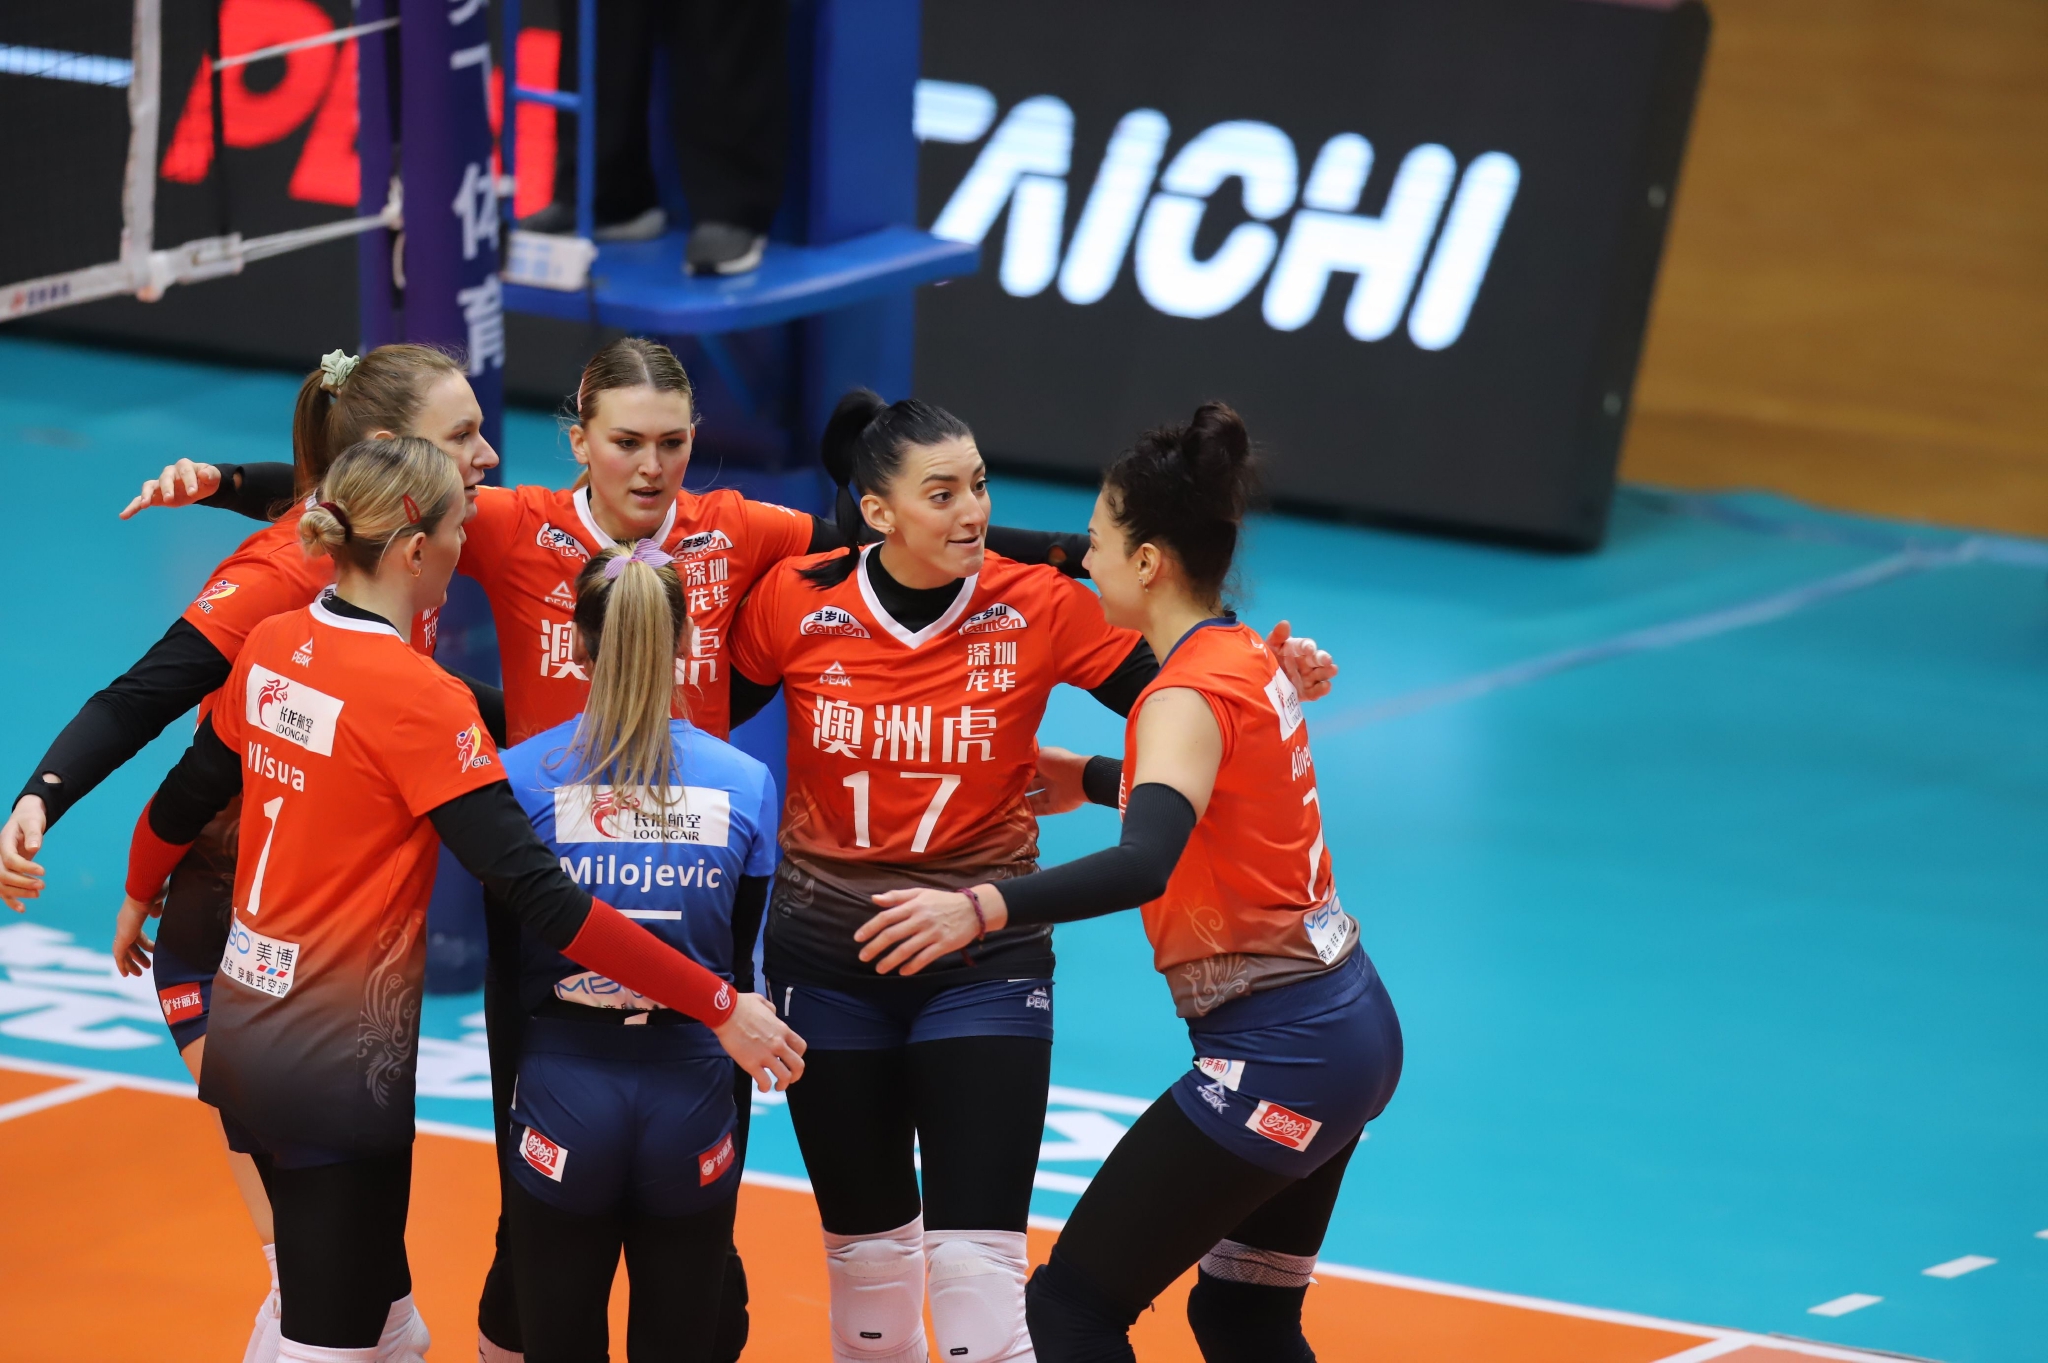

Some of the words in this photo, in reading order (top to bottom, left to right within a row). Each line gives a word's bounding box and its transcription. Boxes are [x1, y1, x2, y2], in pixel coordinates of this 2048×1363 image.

[684, 557, 729, 588] 深圳
[687, 584, 730, 614] 龙华
[291, 650, 314, 669] PEAK
[540, 618, 721, 686] 澳虎
[966, 641, 1018, 667] 深圳
[819, 673, 853, 688] PEAK
[965, 667, 1017, 693] 龙华
[279, 705, 314, 735] 长龙航空
[811, 693, 998, 764] 澳洲虎
[472, 755, 491, 768] CVL
[842, 770, 962, 854] 17
[244, 795, 284, 916] 1
[1302, 786, 1324, 902] 7
[560, 854, 722, 893] Milojevic
[255, 940, 295, 972] 美博
[172, 991, 201, 1011] 好丽友
[555, 975, 645, 999] MB
[1025, 994, 1051, 1012] PEAK
[1201, 1057, 1227, 1074] 伊利
